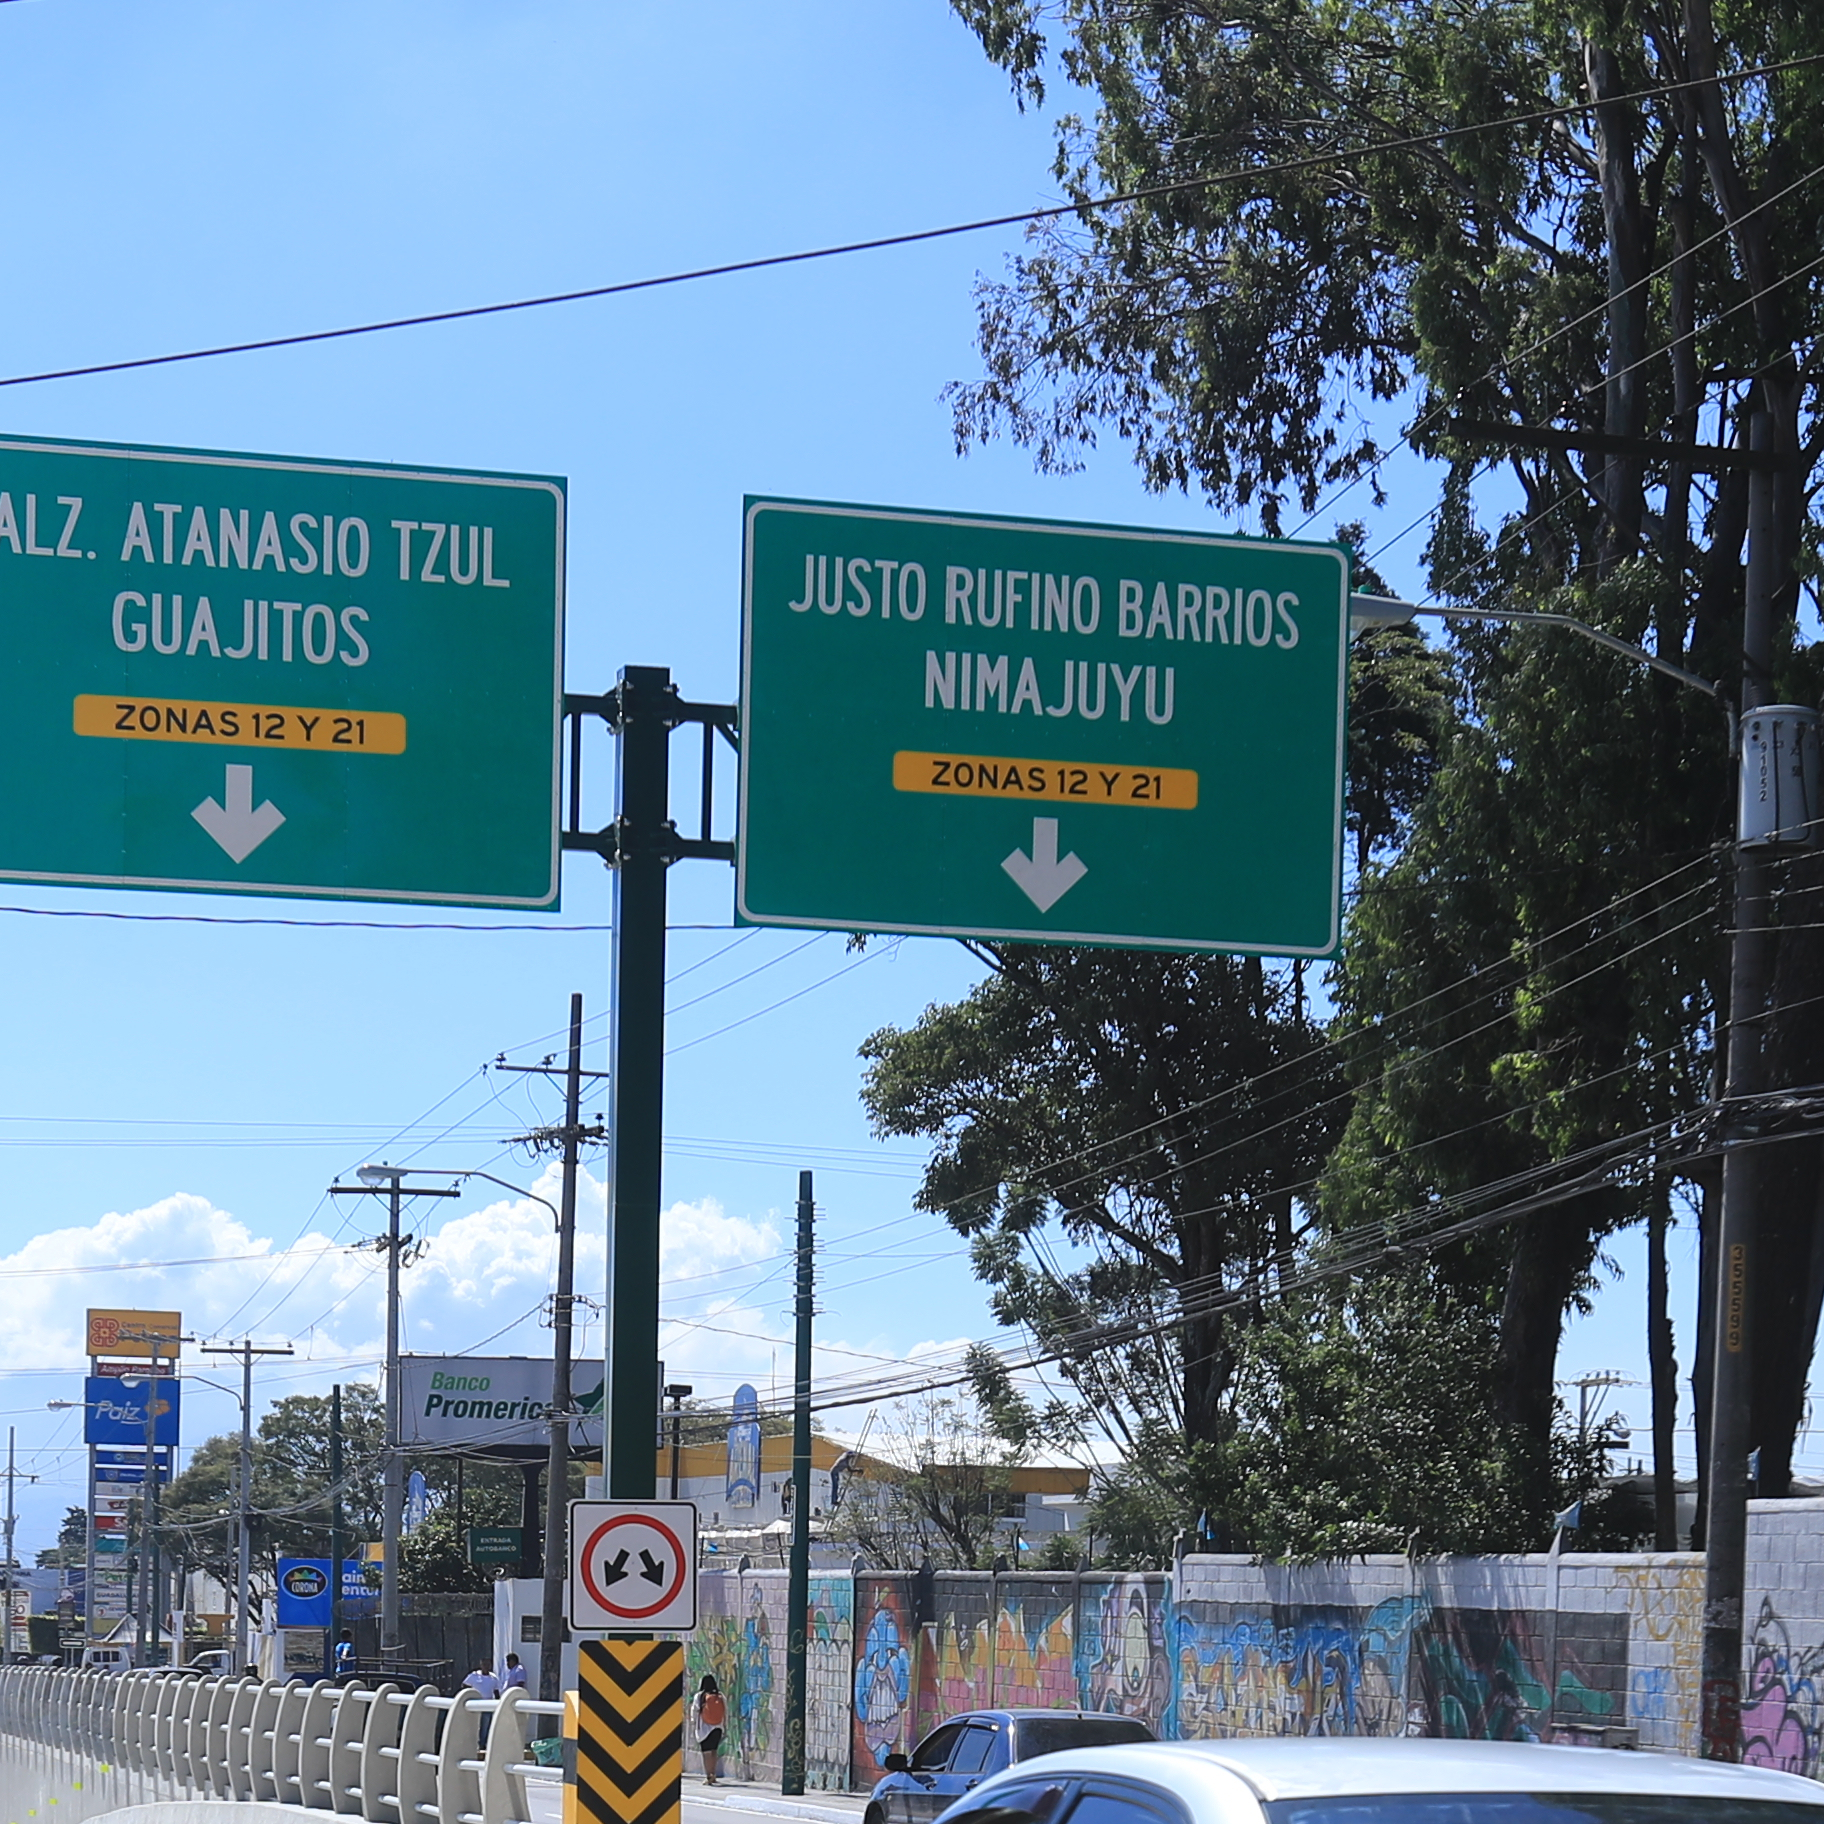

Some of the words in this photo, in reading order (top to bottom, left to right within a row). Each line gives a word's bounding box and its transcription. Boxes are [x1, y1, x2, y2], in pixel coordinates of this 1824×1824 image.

[120, 500, 371, 578] ATANASIO
[390, 518, 511, 588] TZUL
[788, 553, 927, 622] JUSTO
[944, 564, 1102, 635] RUFINO
[1118, 578, 1301, 651] BARRIOS
[112, 590, 371, 667] GUAJITOS
[924, 649, 1175, 726] NIMAJUYU
[114, 703, 241, 739] ZONAS
[251, 712, 286, 741] 12
[296, 715, 324, 743] Y
[330, 717, 368, 746] 21
[931, 760, 1047, 794] ZONAS
[1056, 769, 1089, 796] 12
[1098, 771, 1123, 797] Y
[1130, 773, 1162, 801] 21
[1759, 740, 1768, 802] 91052
[1729, 1245, 1744, 1347] 355599
[424, 1394, 553, 1420] Promeric
[430, 1371, 491, 1392] Banco
[95, 1400, 141, 1421] Paiz
[291, 1581, 319, 1594] CORONA
